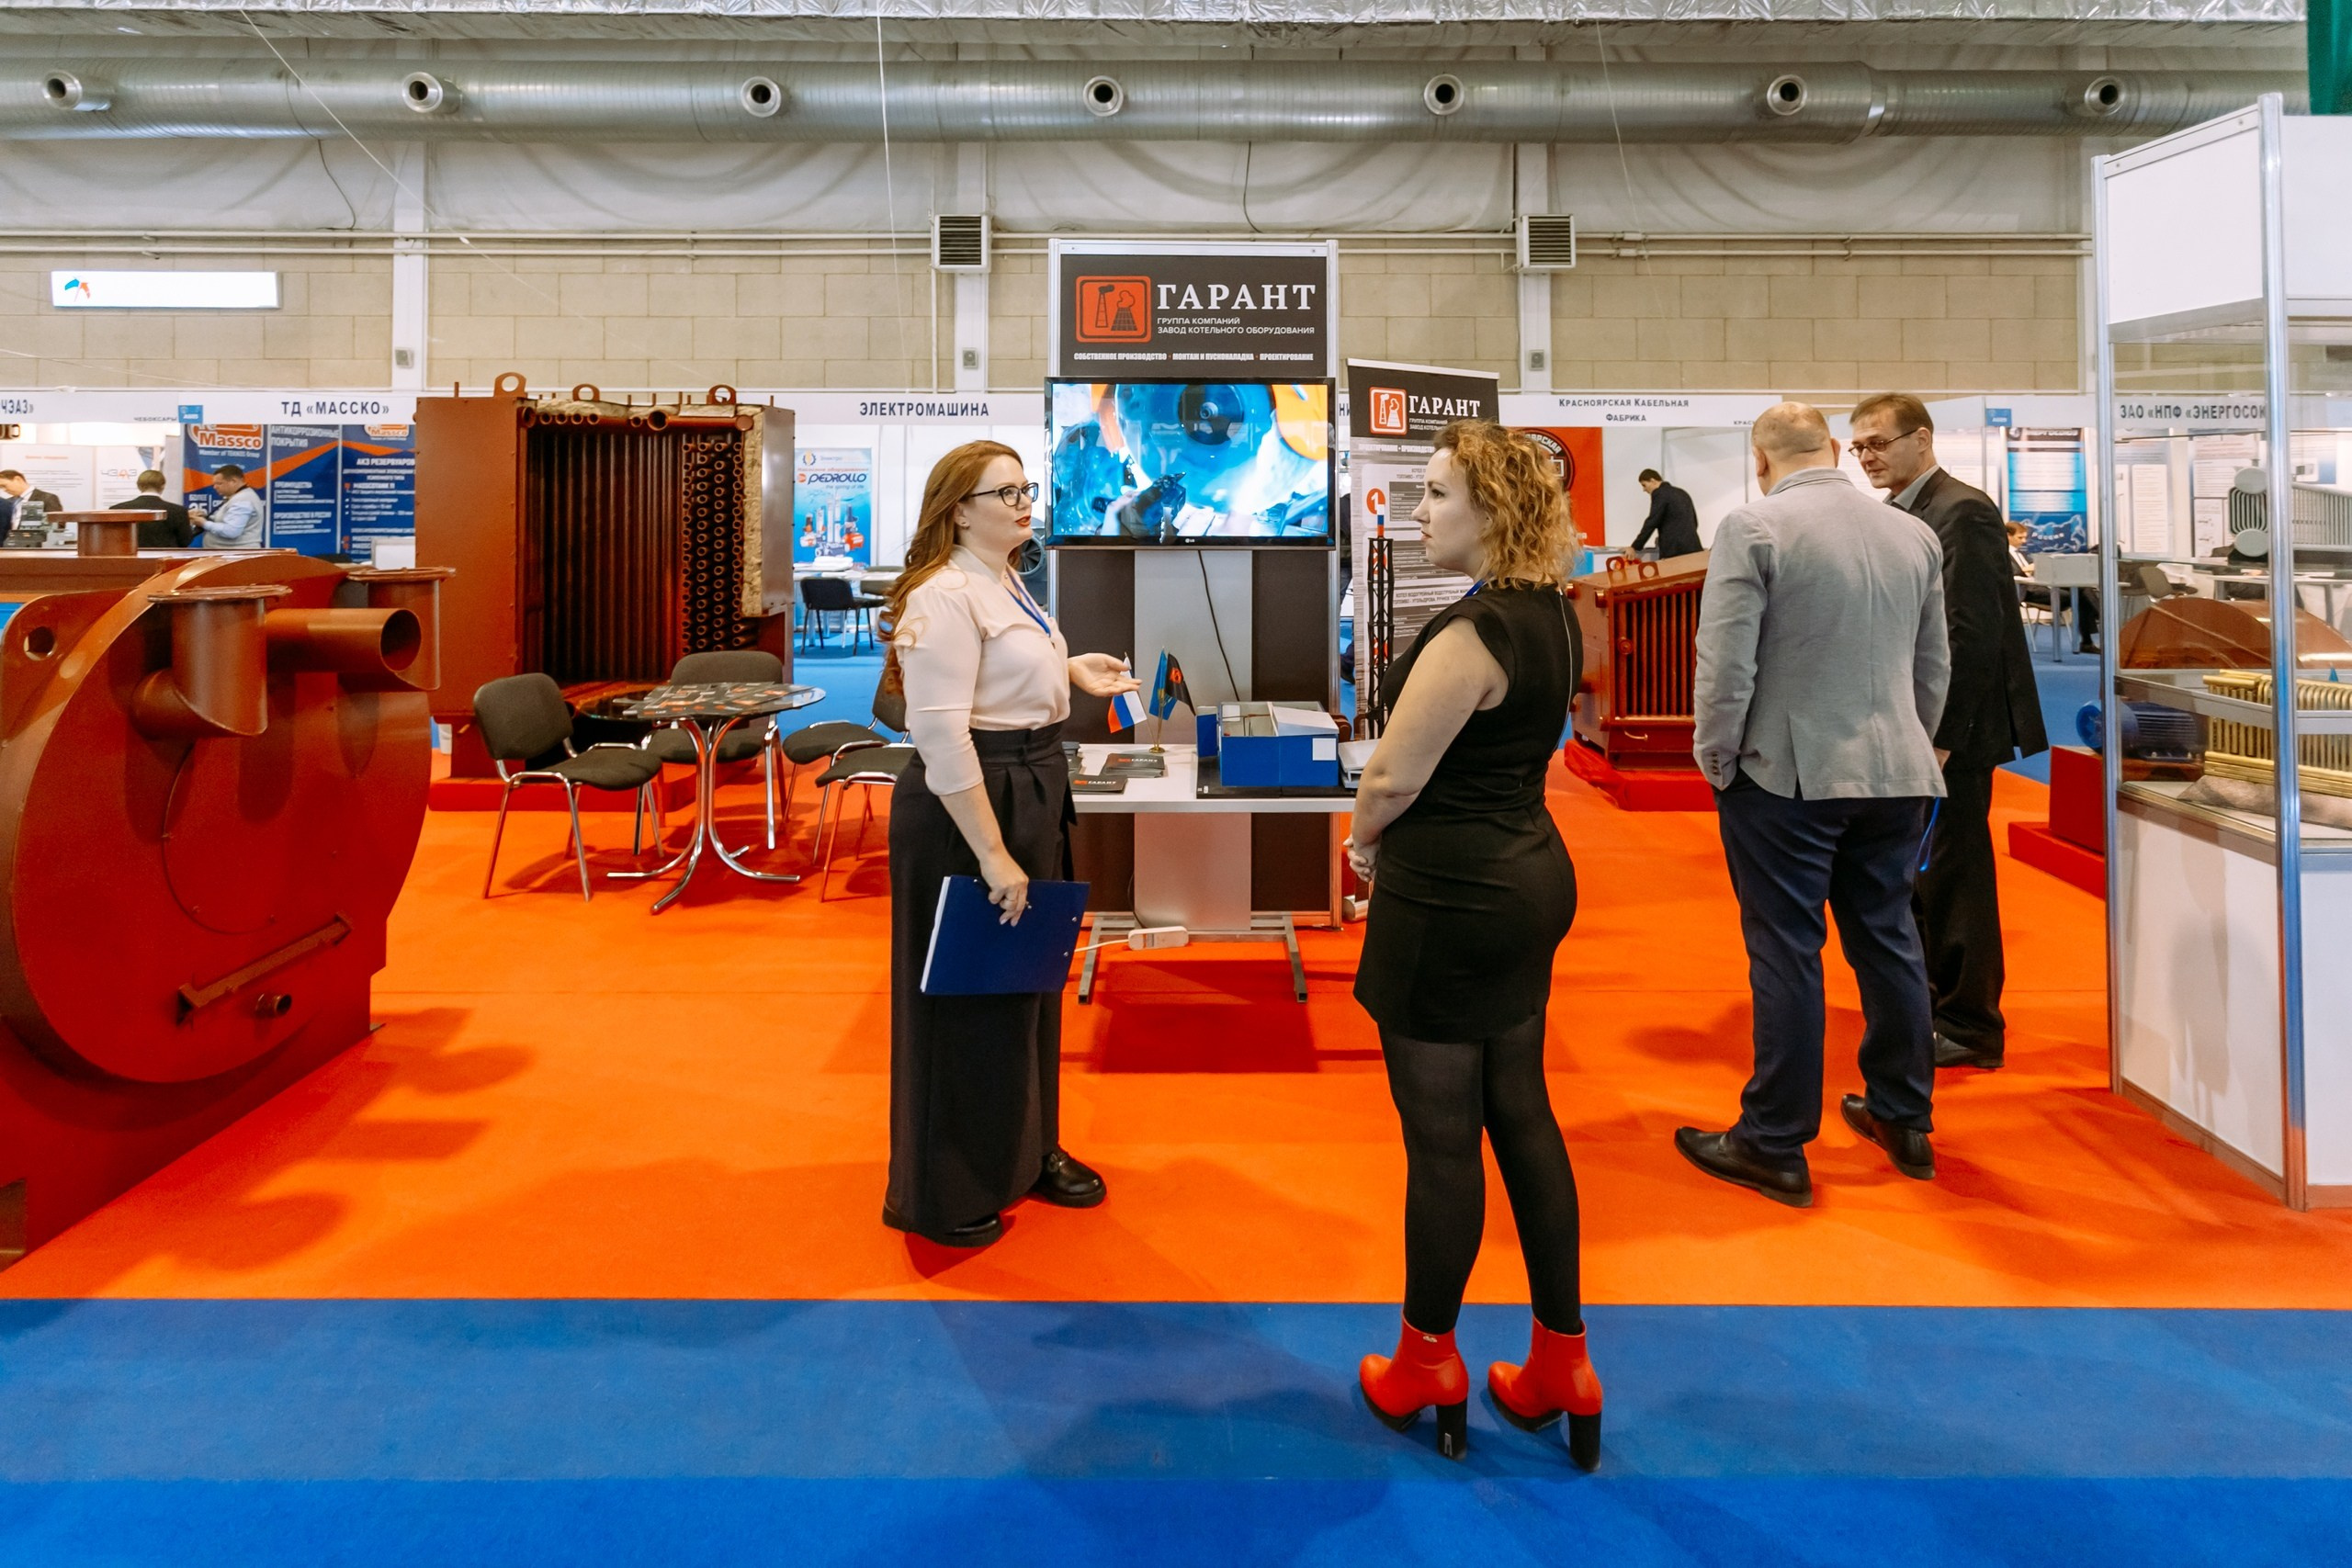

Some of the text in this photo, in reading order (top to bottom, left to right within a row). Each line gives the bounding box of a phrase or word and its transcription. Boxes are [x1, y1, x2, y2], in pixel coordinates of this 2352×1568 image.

[1157, 284, 1316, 310] ГАРАНТ
[1118, 353, 1167, 361] ПРОИЗВОДСТВО
[281, 401, 390, 417] ТД «МАССКО»
[860, 402, 989, 416] ЭЛЕКТРОМАШИНА
[1408, 396, 1480, 417] ГАРАНТ
[2120, 405, 2143, 418] ЗАО
[2148, 405, 2181, 419] «НПФ
[199, 433, 261, 448] Massco
[808, 473, 867, 485] PEDROLLO
